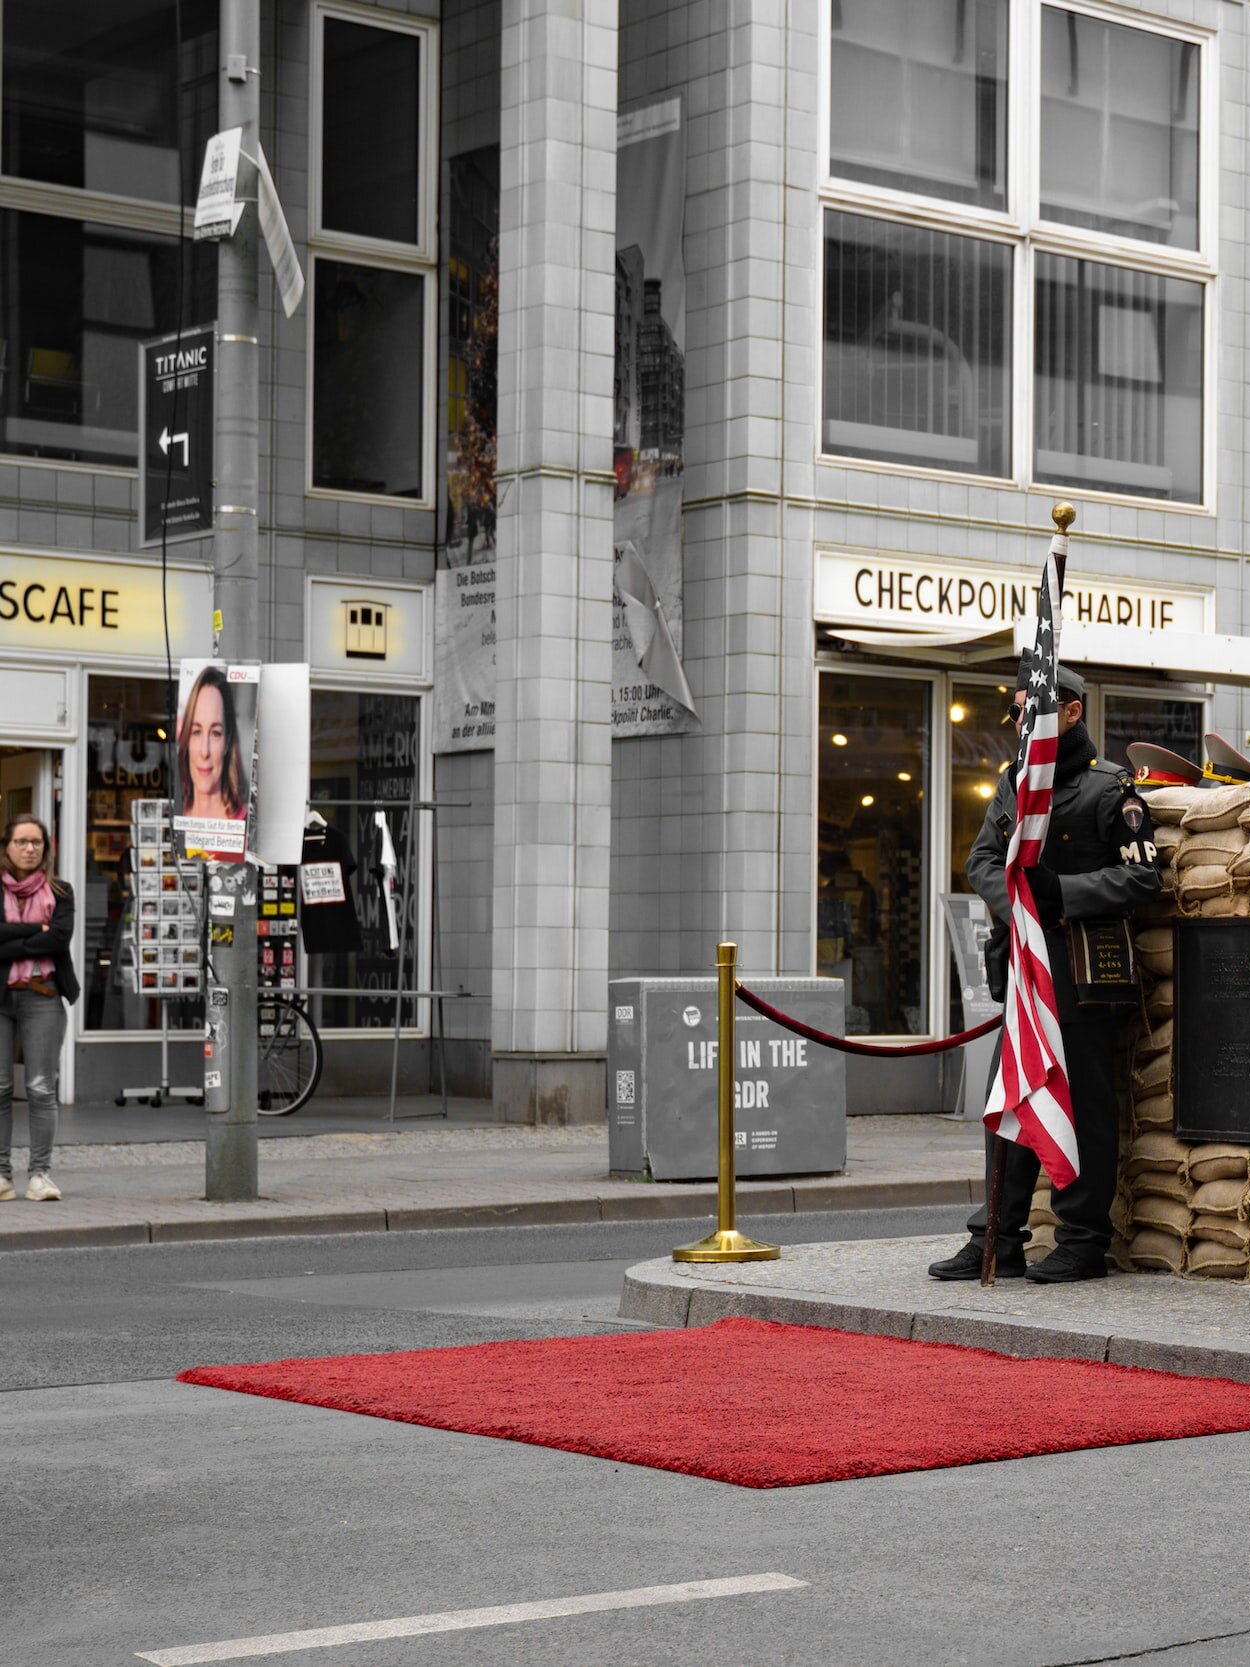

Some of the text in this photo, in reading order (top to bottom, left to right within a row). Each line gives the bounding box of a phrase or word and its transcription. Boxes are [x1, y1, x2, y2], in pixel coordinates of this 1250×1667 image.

[155, 346, 207, 375] TITANIC
[0, 581, 119, 629] SCAFE
[855, 568, 1041, 621] CHECKPOINT
[229, 672, 247, 680] CDU
[617, 1007, 632, 1018] DDR
[688, 1039, 808, 1070] LIF IN THE
